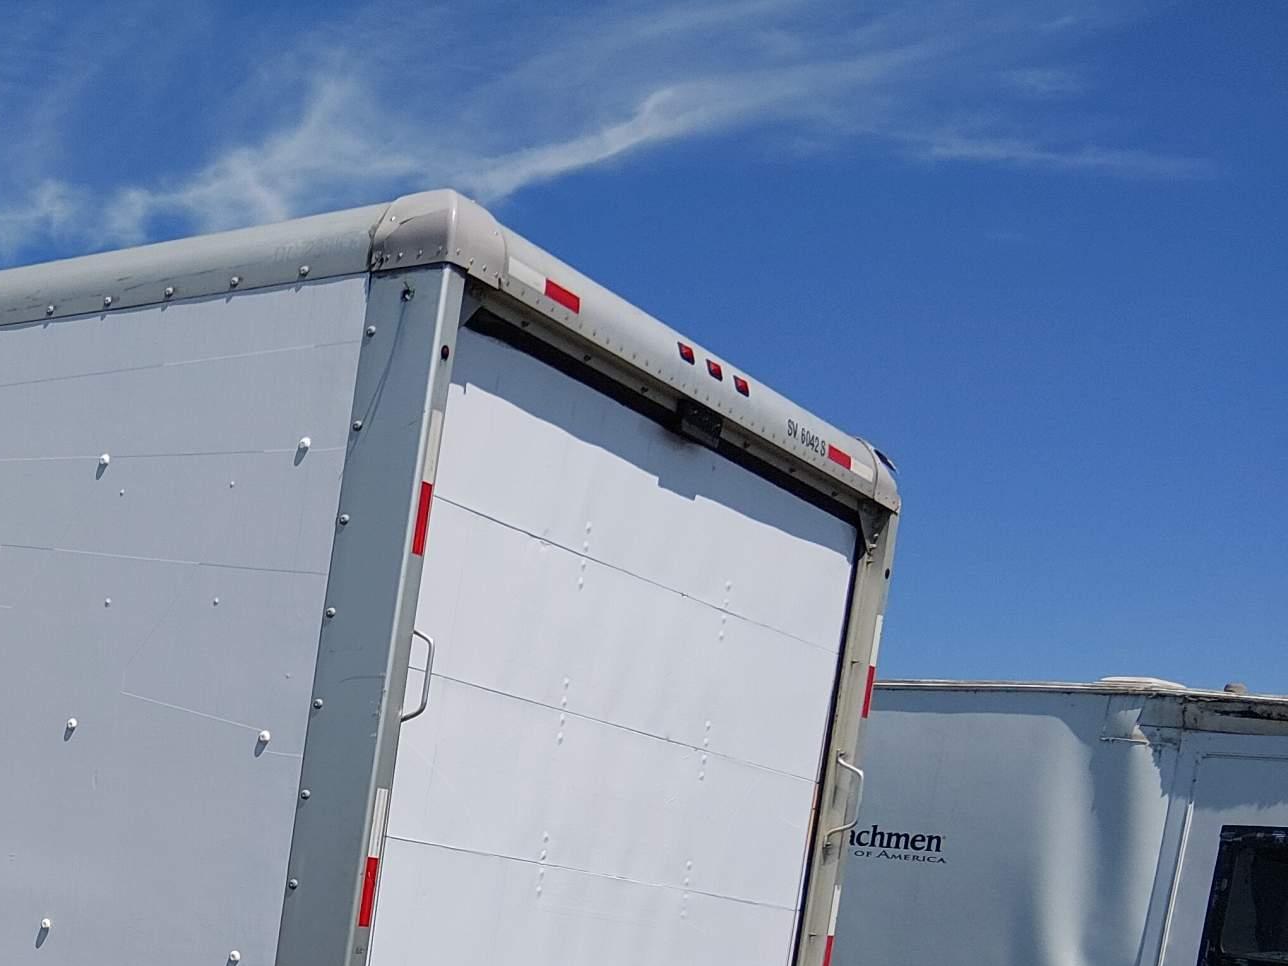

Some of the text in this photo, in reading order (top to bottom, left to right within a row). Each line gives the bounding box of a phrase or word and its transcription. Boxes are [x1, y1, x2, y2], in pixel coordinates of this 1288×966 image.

[787, 418, 799, 439] SV
[800, 427, 820, 454] 6042
[854, 849, 947, 864] OF AMERICA
